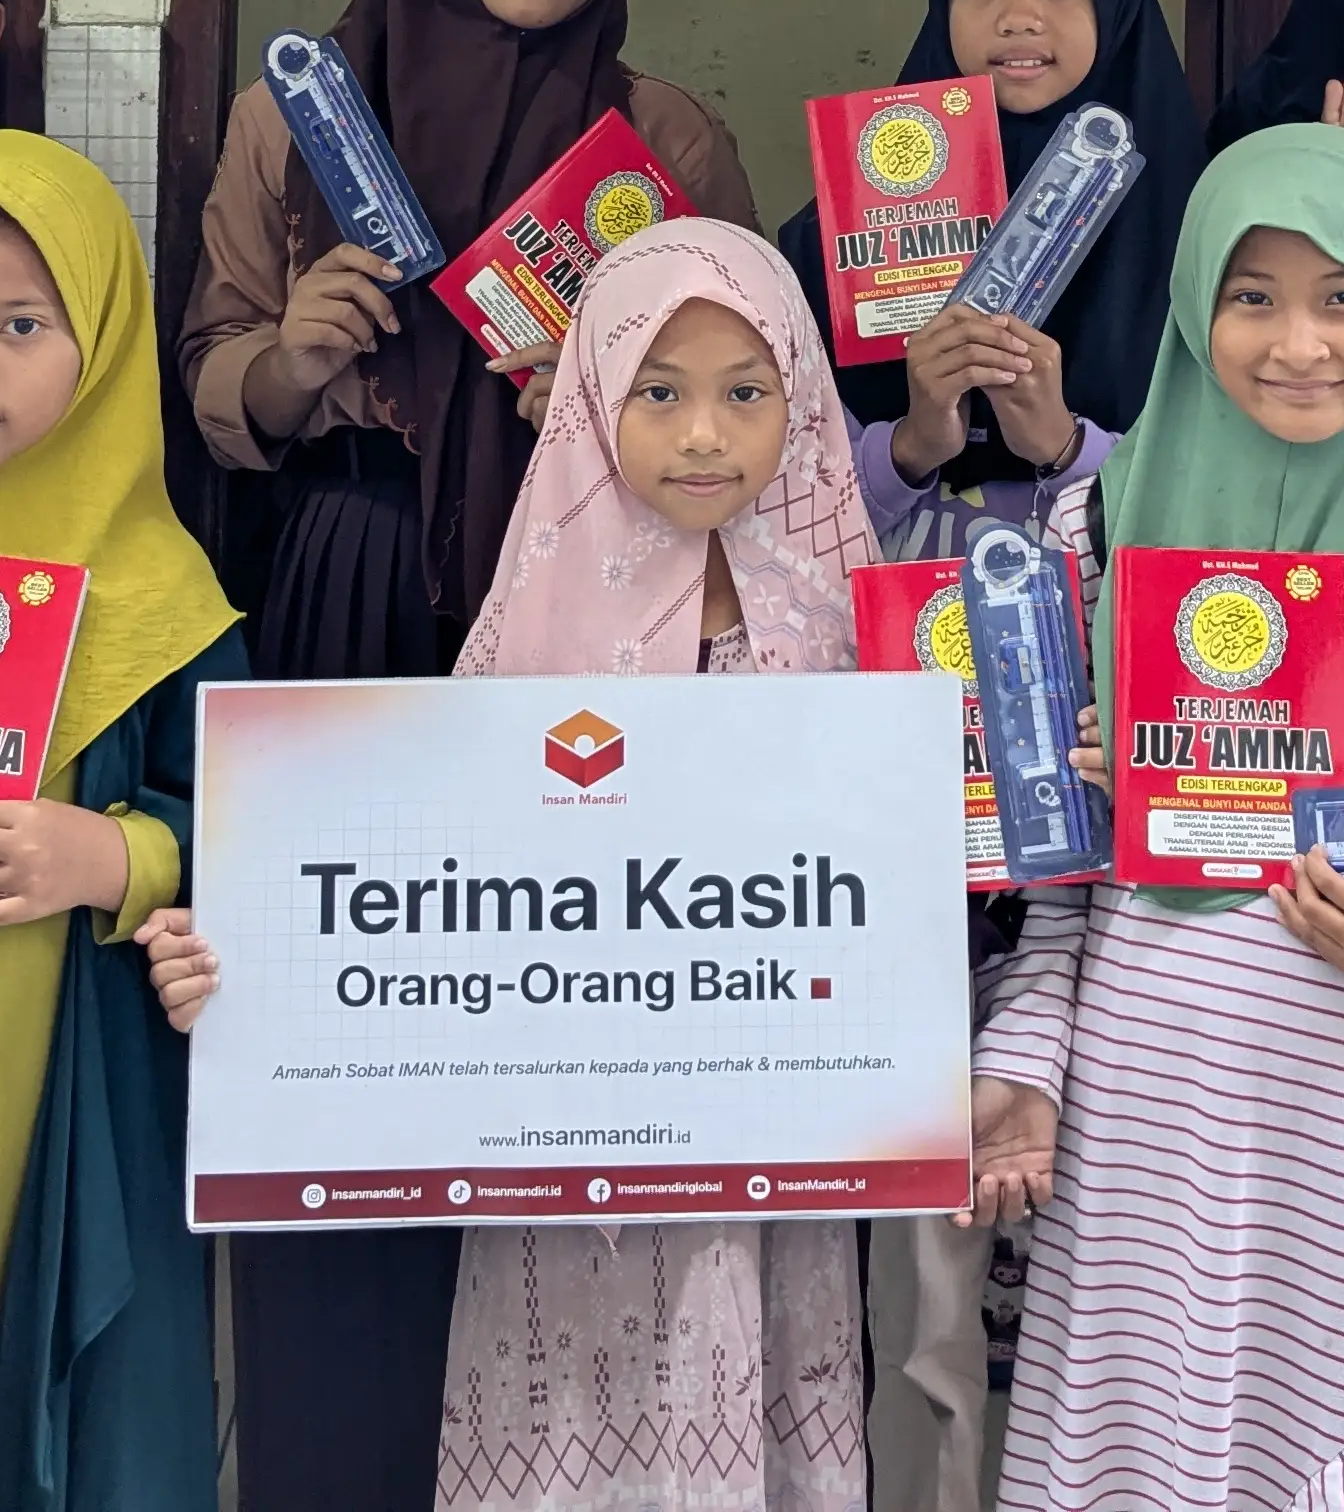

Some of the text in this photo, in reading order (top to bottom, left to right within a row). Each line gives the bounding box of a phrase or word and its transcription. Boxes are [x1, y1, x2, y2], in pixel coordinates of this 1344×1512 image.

[864, 197, 959, 227] TERJEMAH
[503, 211, 558, 268] JUZ
[551, 218, 599, 275] TERJEM
[836, 228, 888, 272] JUZ
[877, 262, 959, 282] EDISI TERLENGKAP
[516, 266, 570, 326] EDISI TERLENGKAP
[854, 289, 896, 300] MENGENAL
[897, 284, 921, 294] BUNYI
[921, 281, 938, 290] DAN
[1173, 695, 1291, 724] TERJEMAH
[1131, 722, 1196, 769] JUZ
[1181, 778, 1283, 793] EDISI TERLENGKAP
[542, 792, 627, 805] Insan Mandiri
[1149, 796, 1201, 808] MENGENAL
[1203, 799, 1232, 809] BUNYI
[1234, 800, 1253, 810] DAN
[1255, 801, 1287, 812] TANDA
[1174, 812, 1290, 824] DISERTAI BAHASA INDONESIA
[1174, 821, 1207, 829] DENGAN
[1189, 830, 1275, 840] DENGAN PERUBAHAN
[1256, 841, 1294, 849] INDONES
[300, 852, 867, 935] Terima Kasih
[336, 957, 798, 1015] Orang-Orang Baik
[272, 1054, 896, 1080] Amanah Sobat IMAN telah tersalurkan kepada yang berhak & membutuhkan.
[478, 1123, 691, 1147] www.insanmandiri.id
[331, 1186, 422, 1201] insanmandiri_id
[777, 1178, 866, 1192] InsanMandiri_id
